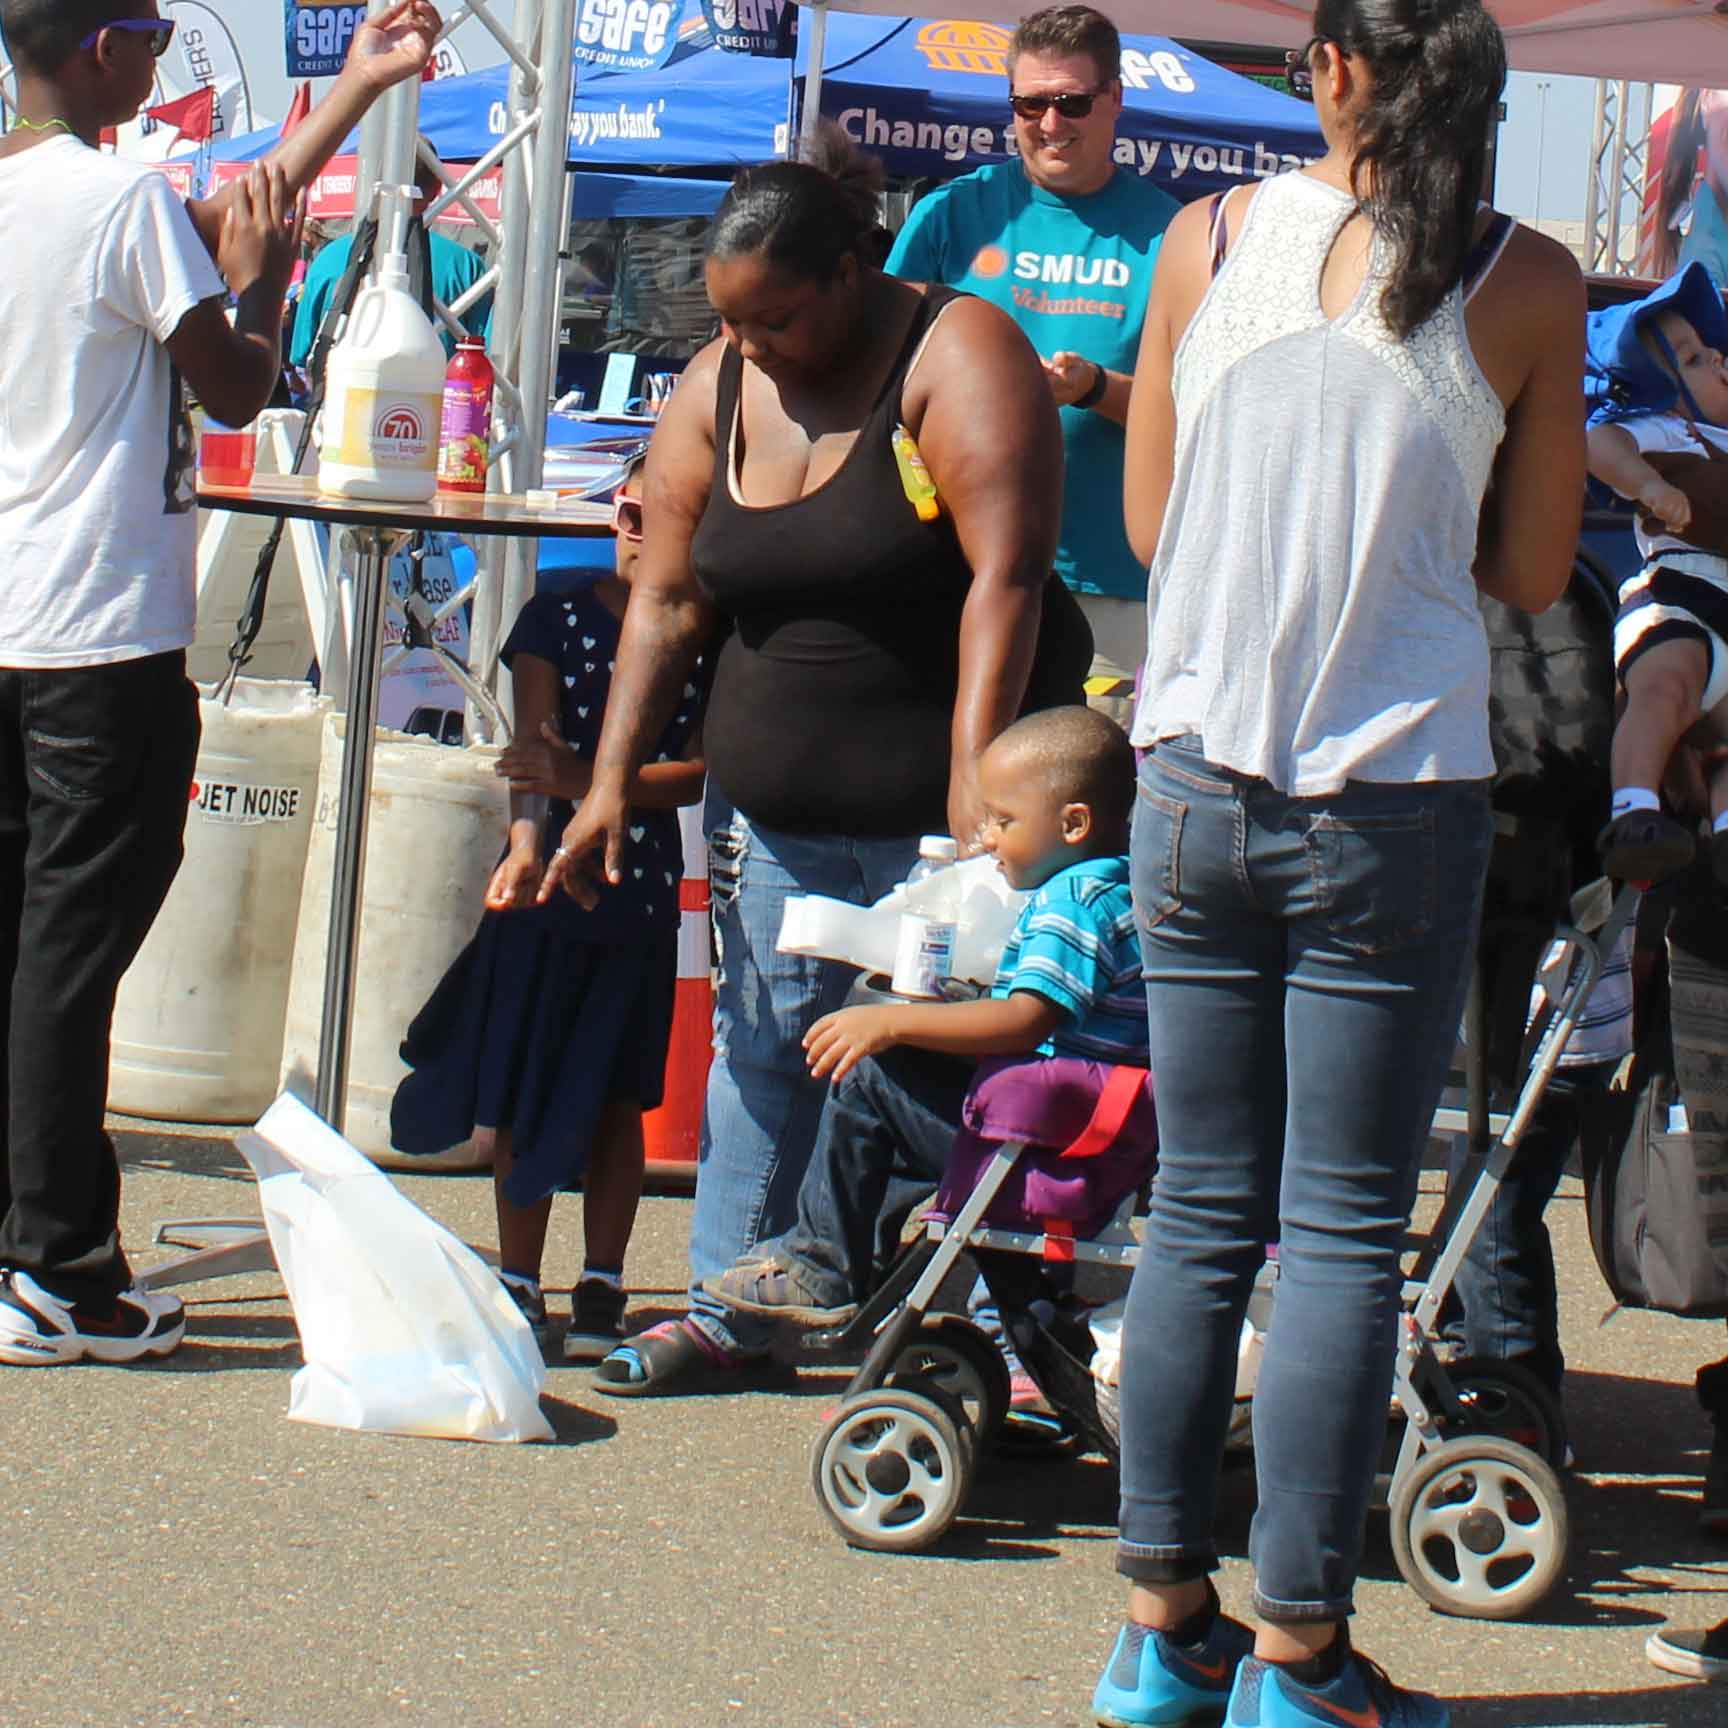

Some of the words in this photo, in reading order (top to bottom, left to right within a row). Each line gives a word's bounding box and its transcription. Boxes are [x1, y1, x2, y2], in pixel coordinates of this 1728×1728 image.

[574, 46, 617, 65] CREDIT
[589, 112, 618, 146] you
[838, 107, 1005, 160] Change
[1171, 141, 1247, 179] you
[1013, 251, 1130, 288] SMUD
[1011, 284, 1127, 319] Volunteer
[199, 783, 237, 813] JET
[243, 787, 299, 817] NOISE
